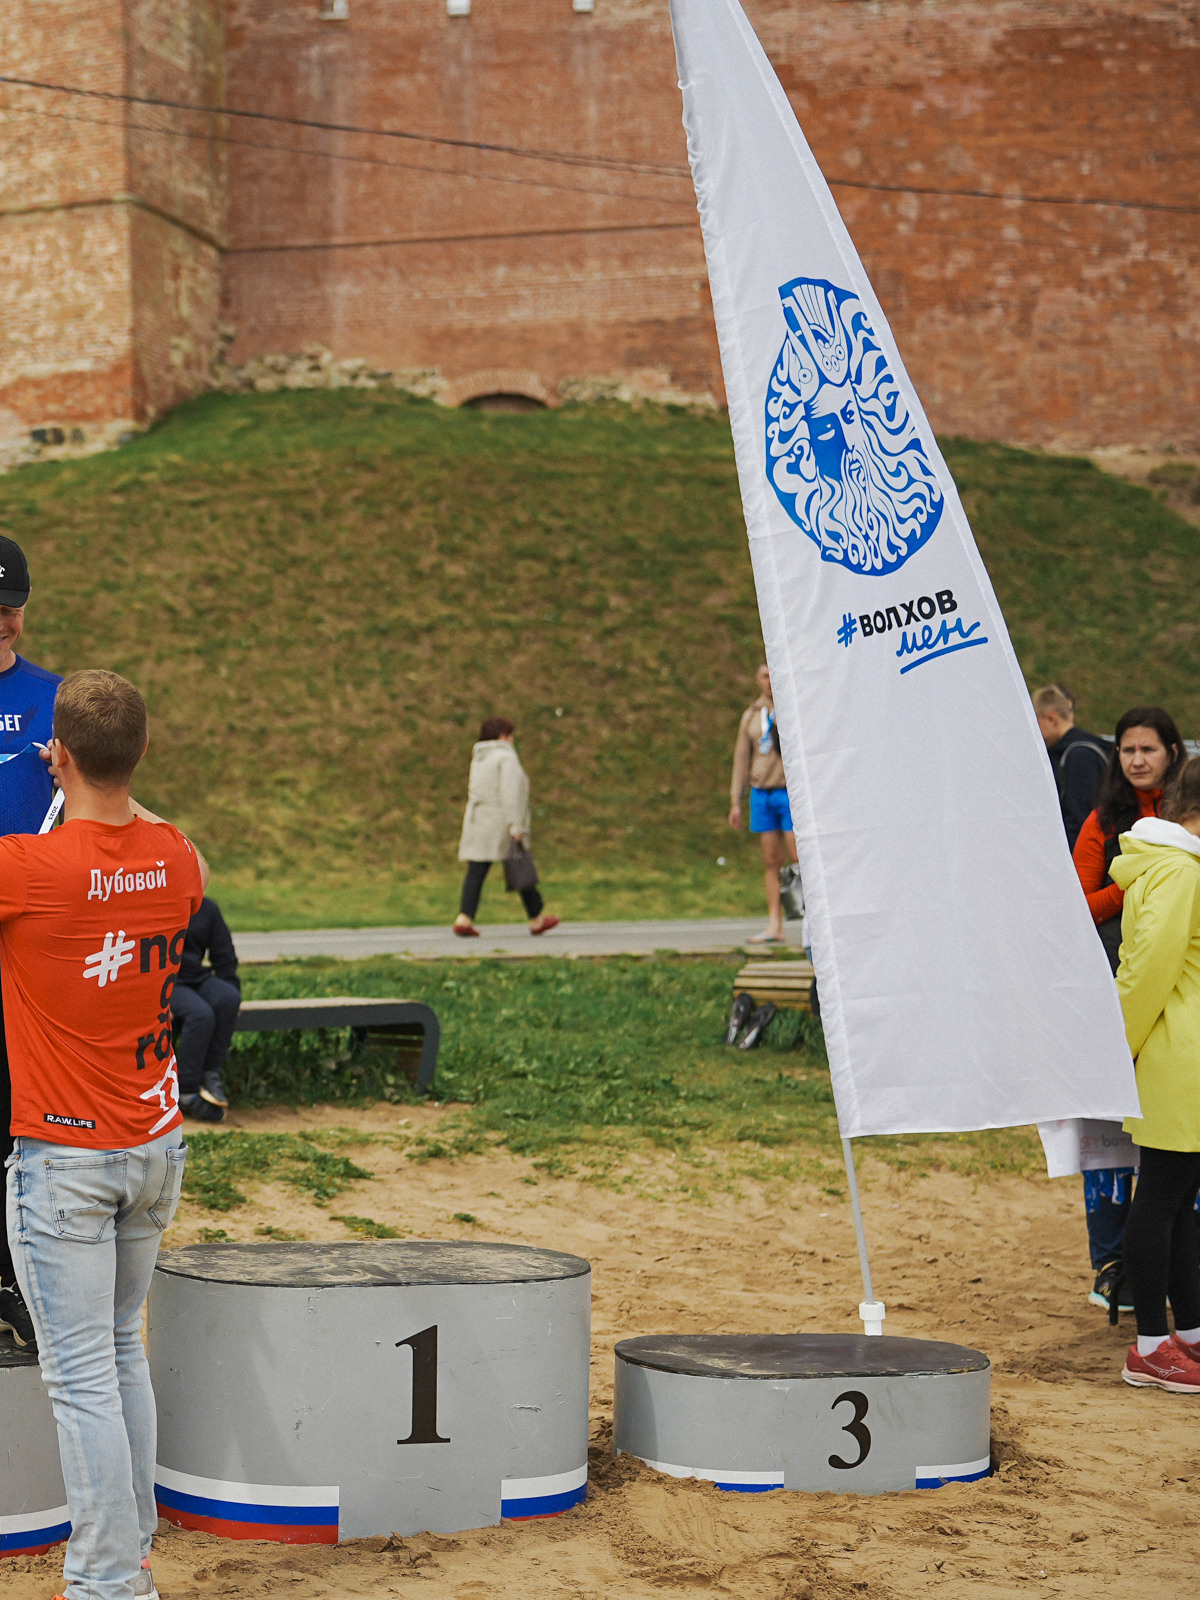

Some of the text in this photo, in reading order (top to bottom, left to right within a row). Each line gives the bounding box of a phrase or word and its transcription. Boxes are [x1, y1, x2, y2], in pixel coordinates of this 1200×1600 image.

[837, 589, 958, 647] #ВОЛХОВ
[87, 860, 167, 902] Дубовой
[395, 1325, 450, 1444] 1
[828, 1391, 872, 1469] 3
